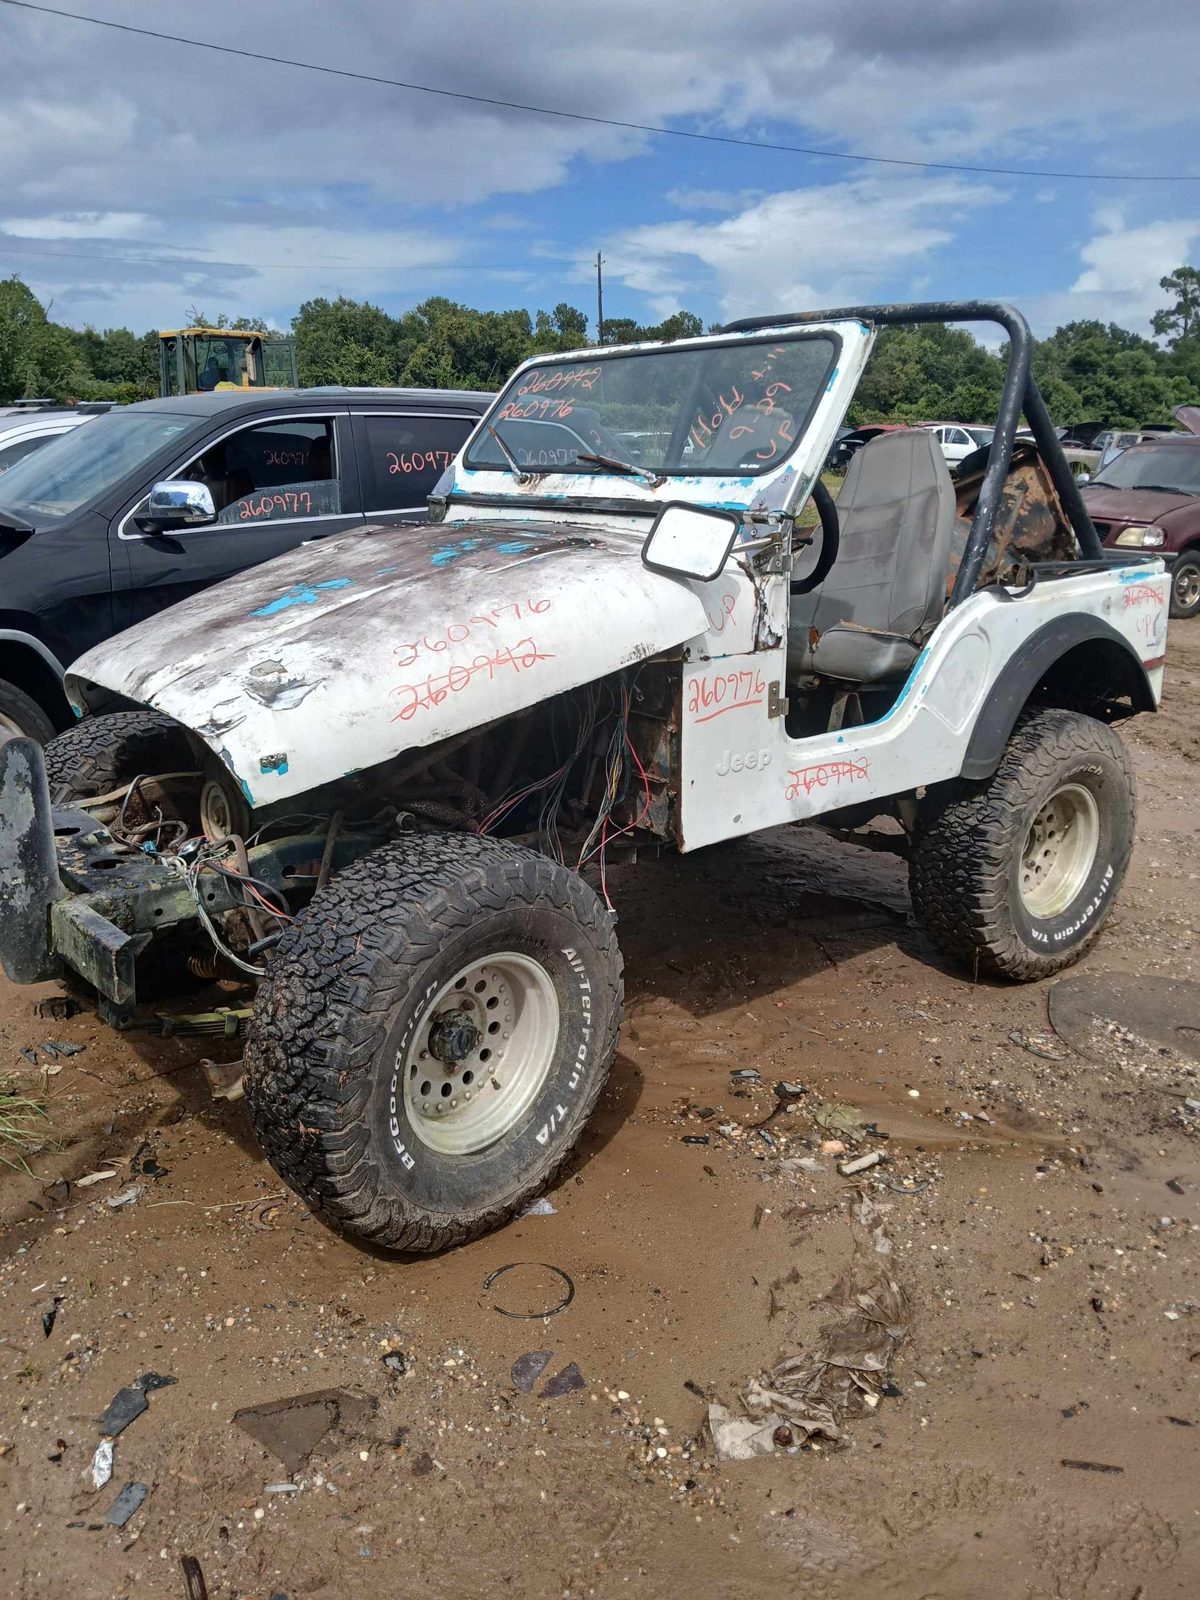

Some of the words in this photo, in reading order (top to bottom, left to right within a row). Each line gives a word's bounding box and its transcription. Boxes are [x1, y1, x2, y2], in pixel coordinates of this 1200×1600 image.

[498, 398, 577, 420] 260976
[691, 385, 744, 448] Hold
[729, 382, 792, 439] 9-29
[756, 420, 794, 459] UP
[237, 492, 313, 519] 260977
[392, 598, 551, 667] 260976
[708, 594, 737, 632] UP
[688, 668, 767, 713] 260976
[716, 748, 773, 777] Jeep
[1053, 863, 1115, 942] All-Terrain
[560, 947, 593, 1090] All-Terrain
[389, 980, 439, 1170] BFGoodrich
[535, 1103, 569, 1146] T/A
